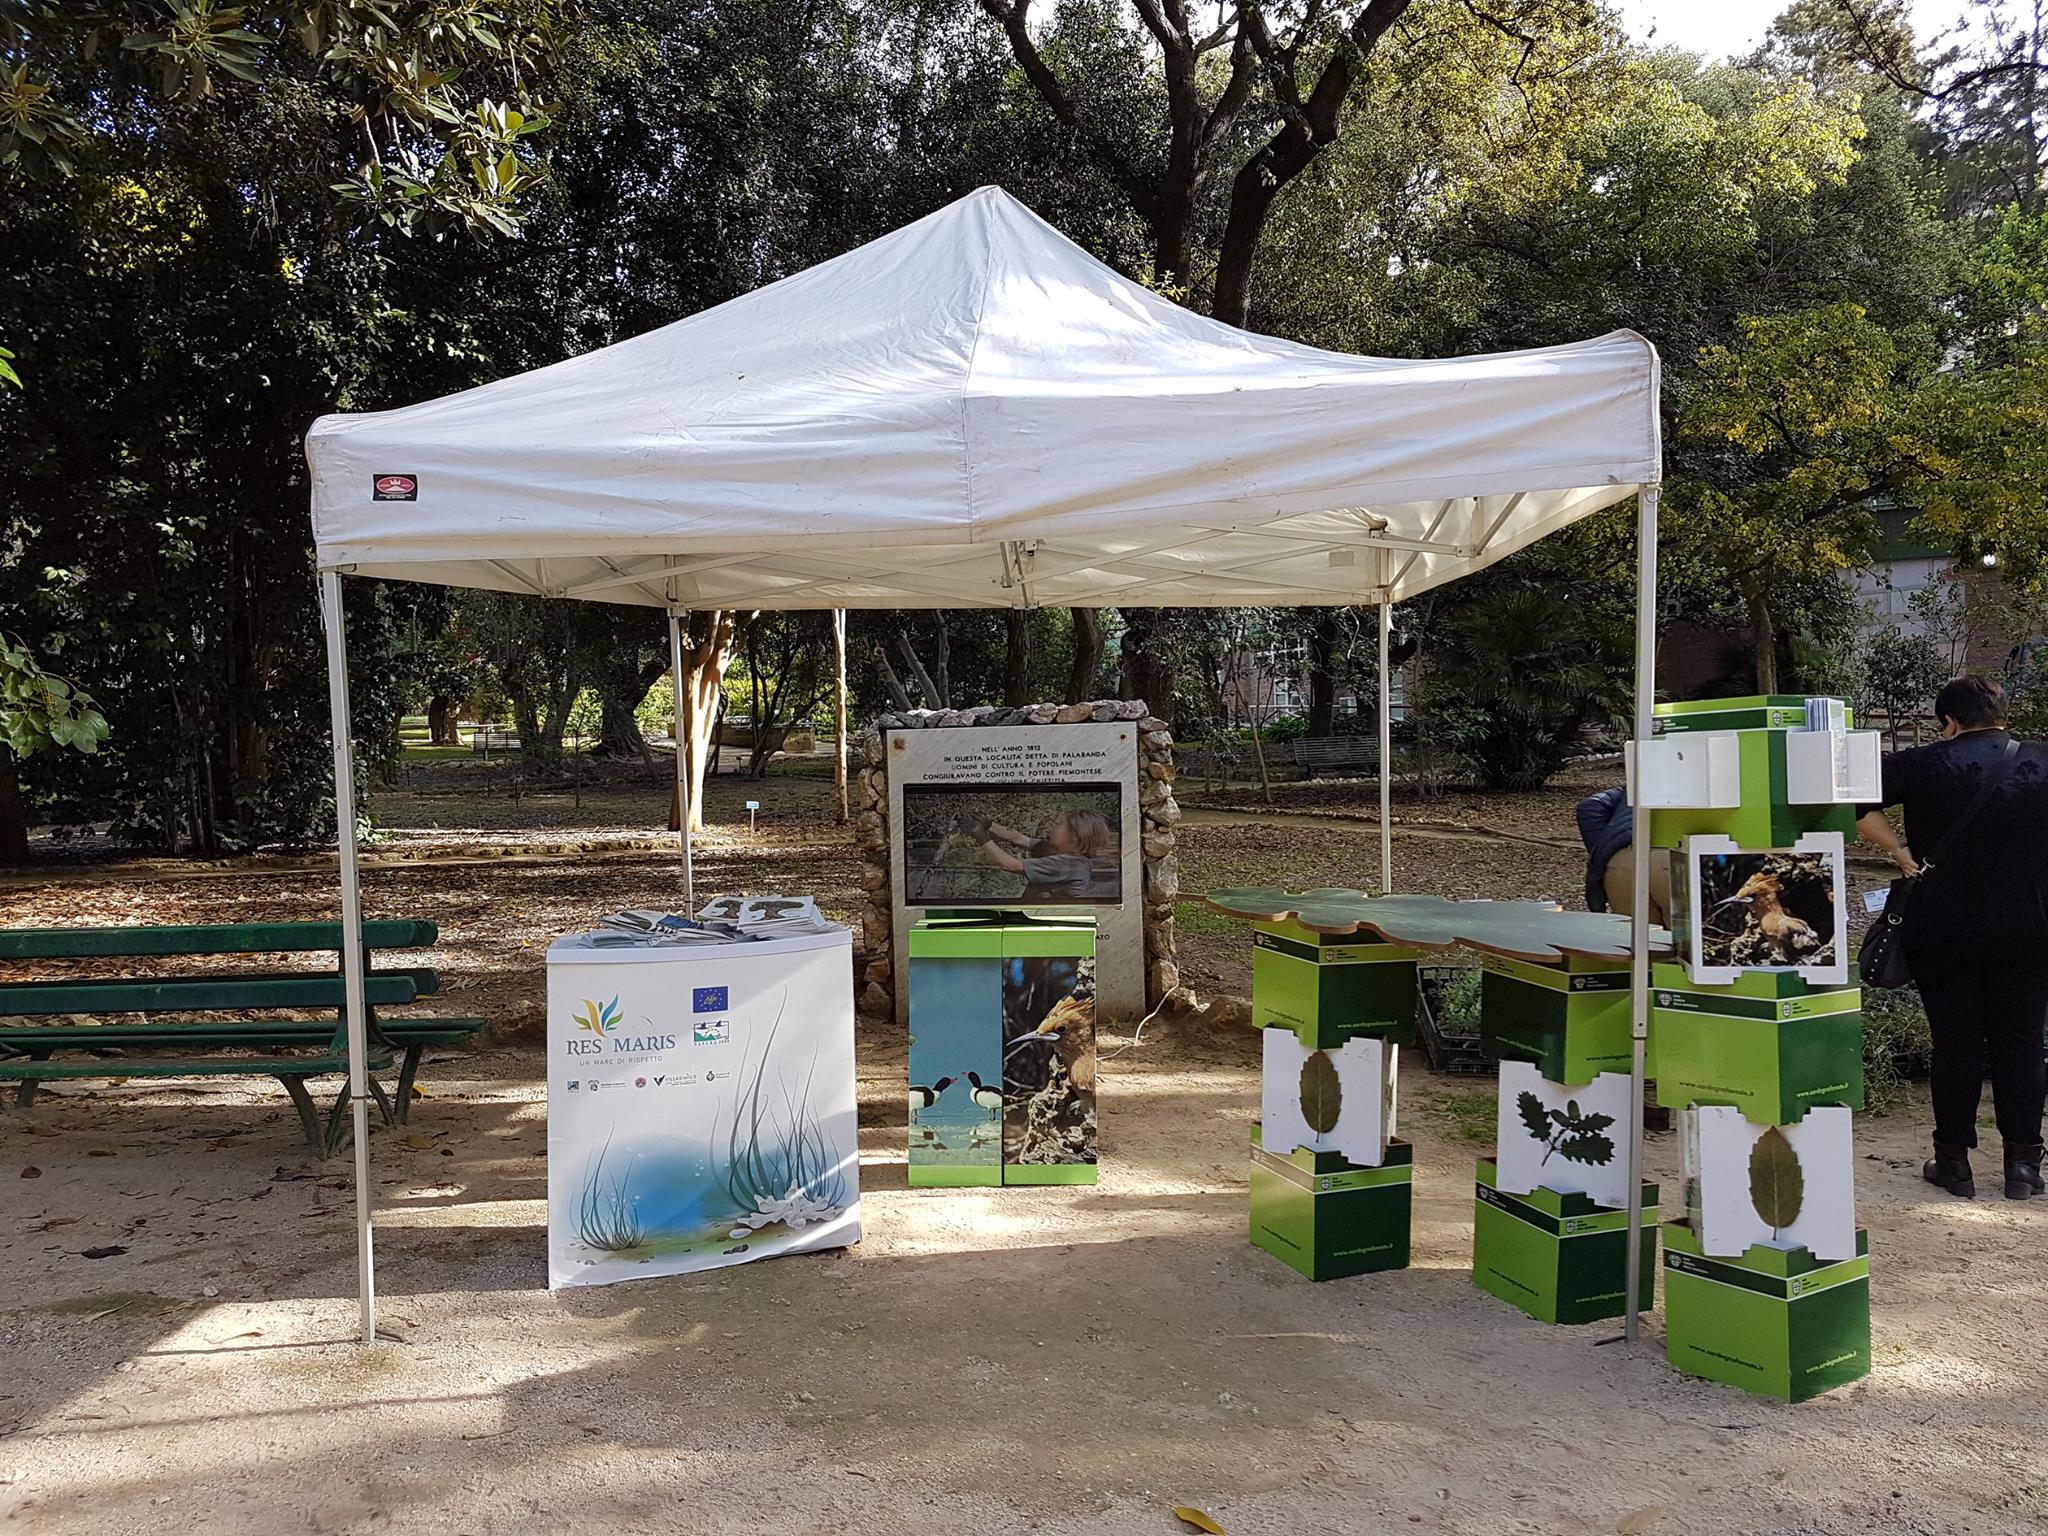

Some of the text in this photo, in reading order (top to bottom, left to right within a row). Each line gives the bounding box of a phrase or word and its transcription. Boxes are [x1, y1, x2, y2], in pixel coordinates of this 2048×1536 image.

[1062, 751, 1107, 759] PALABANDA
[991, 762, 1025, 770] CULTURA
[922, 772, 982, 780] CONGIURAVANO
[1028, 769, 1055, 777] POTERE
[1058, 768, 1103, 776] PIEMONTESE
[566, 1034, 677, 1056] RES MARIS
[579, 1055, 663, 1067] UN MARE DI RISPETTO
